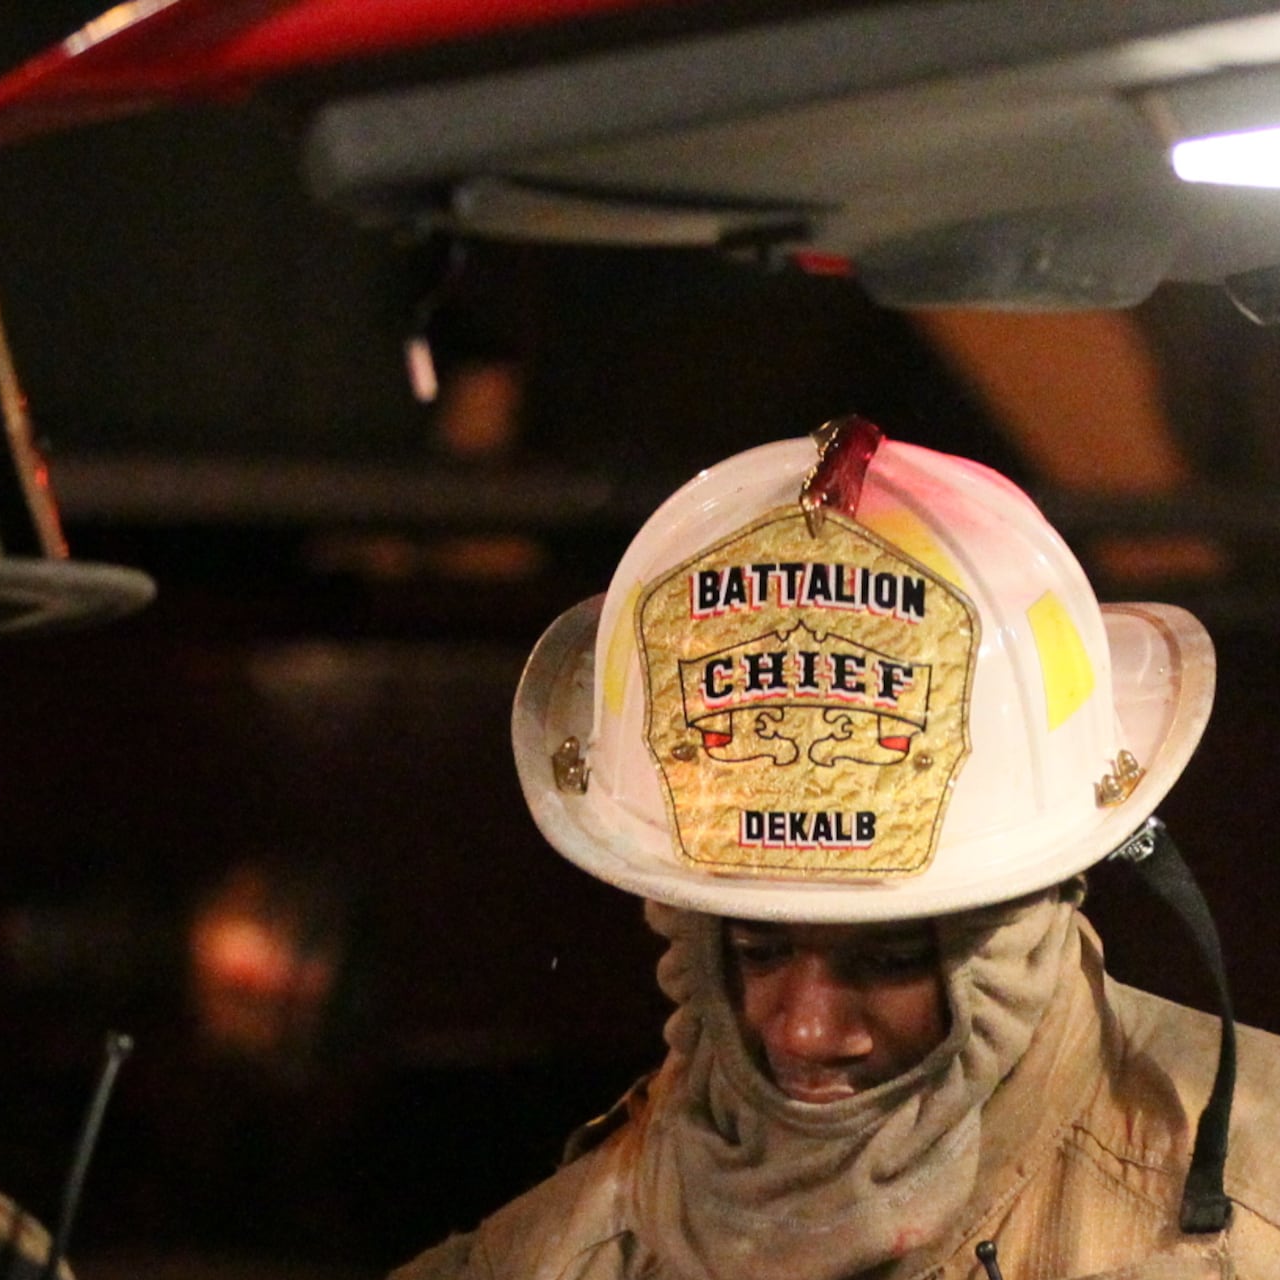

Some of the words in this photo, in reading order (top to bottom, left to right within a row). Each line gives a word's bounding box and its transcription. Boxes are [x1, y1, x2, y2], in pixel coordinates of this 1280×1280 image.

[691, 562, 926, 619] BATTALION
[700, 650, 915, 708] CHIEF
[739, 809, 878, 848] DEKALB
